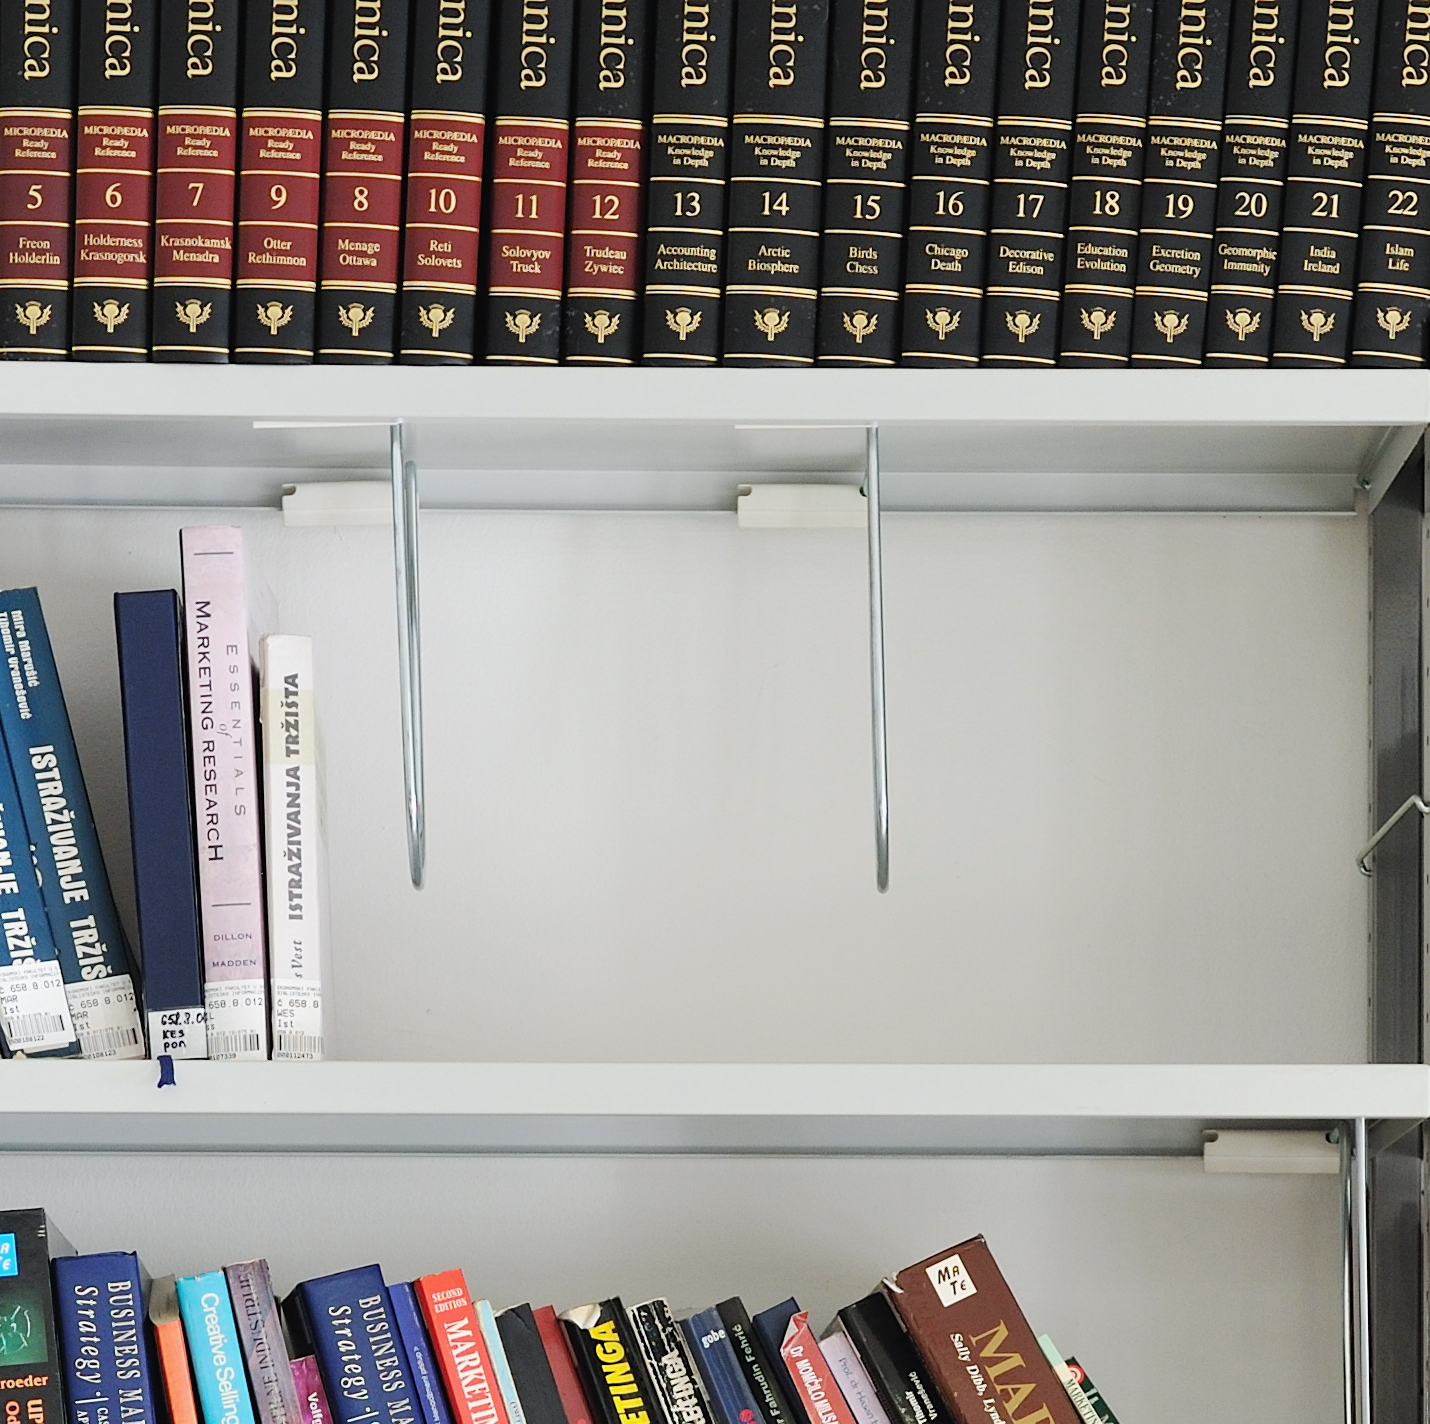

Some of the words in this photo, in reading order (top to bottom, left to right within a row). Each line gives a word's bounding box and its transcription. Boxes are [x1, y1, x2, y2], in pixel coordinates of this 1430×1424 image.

[105, 183, 123, 207] 6
[352, 187, 369, 211] 8
[428, 188, 457, 213] 10
[1093, 190, 1121, 216] 18
[592, 195, 620, 220] 12
[674, 191, 701, 217] 13
[853, 194, 881, 220] 15
[1388, 190, 1418, 217] 22
[83, 234, 144, 248] Holderness
[338, 239, 380, 255] Menage
[80, 249, 147, 264] Krasnogorsk
[583, 246, 628, 260] Trudeau
[657, 244, 717, 260] Accounting
[849, 247, 878, 260] Birds
[1077, 243, 1128, 258] Education
[1385, 243, 1415, 257] Islam
[339, 253, 377, 267] Ottawa
[418, 254, 462, 269] Solovets
[584, 260, 625, 276] Zywiec
[654, 257, 718, 273] Architecture
[847, 261, 879, 275] Chess
[1077, 257, 1127, 273] Evolution
[1388, 258, 1410, 271] Life
[280, 673, 301, 758] TRŽIŠTA
[283, 765, 304, 922] ISTRAŽIVANJA
[107, 1280, 137, 1381] BUSINESS
